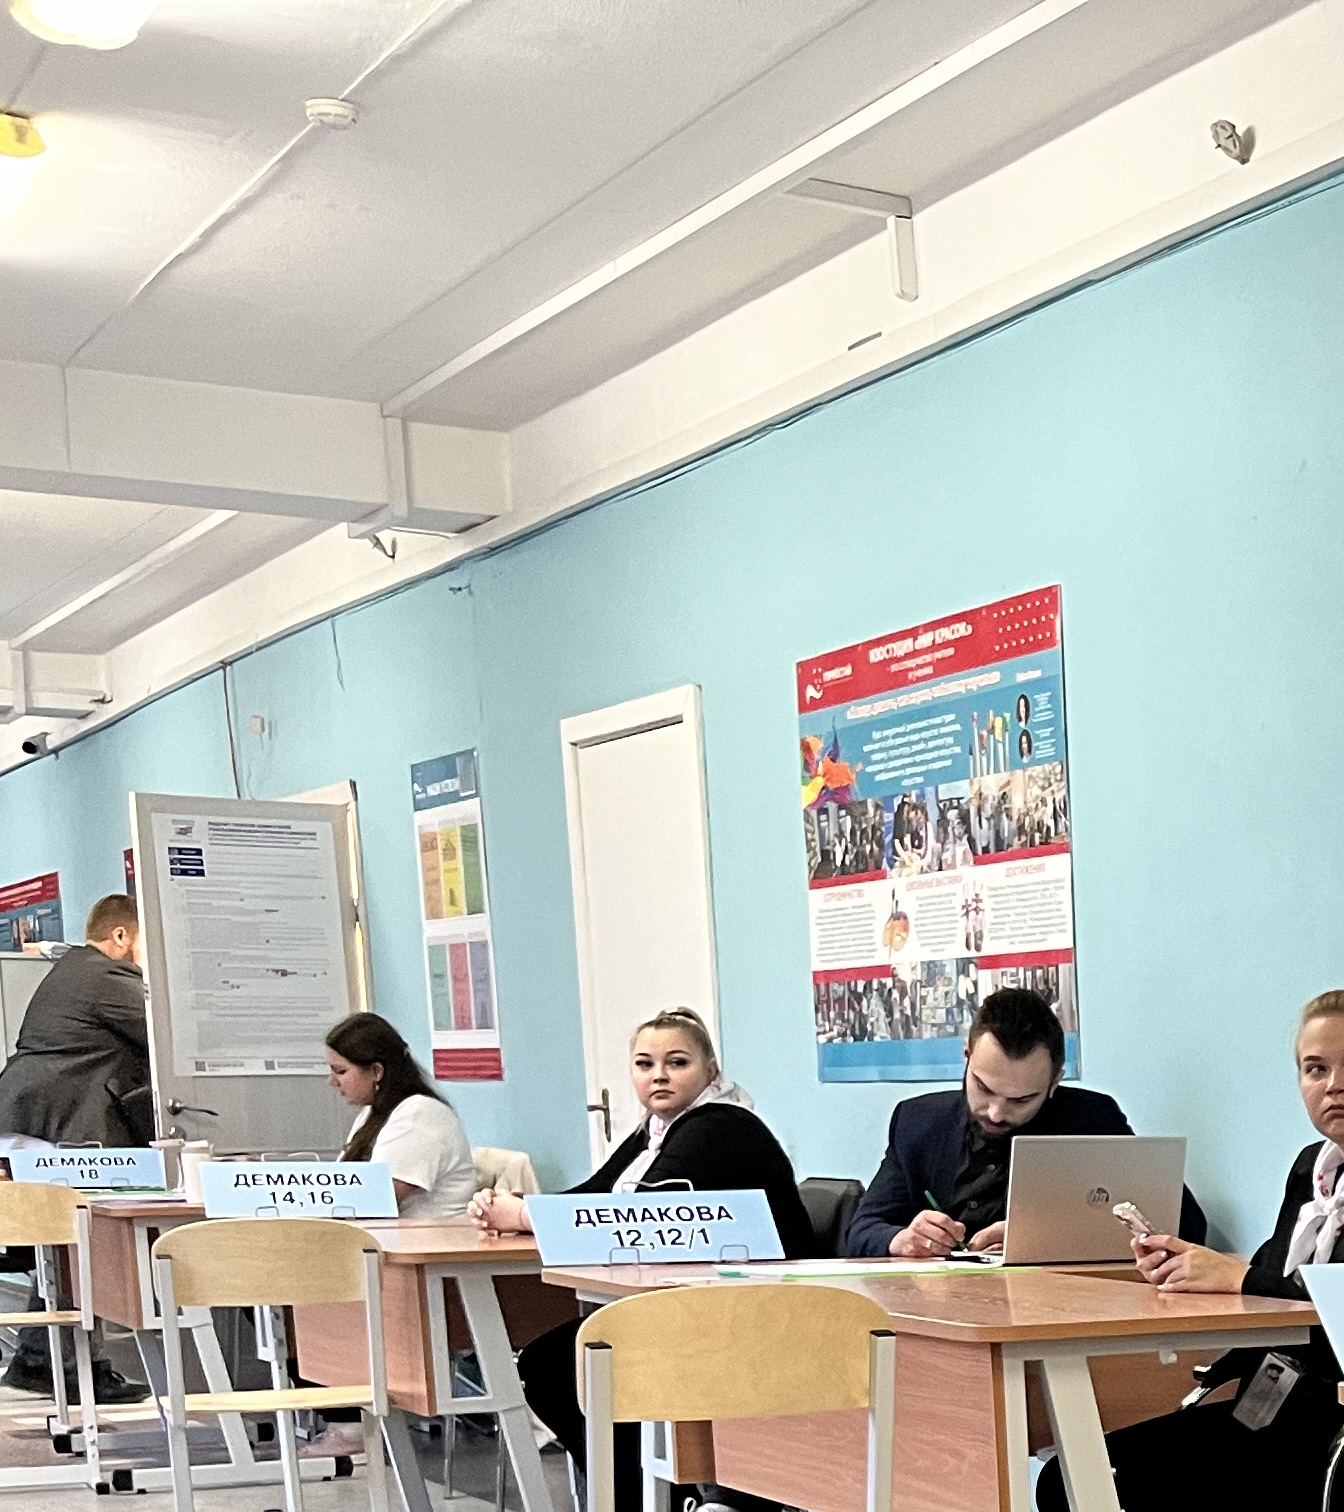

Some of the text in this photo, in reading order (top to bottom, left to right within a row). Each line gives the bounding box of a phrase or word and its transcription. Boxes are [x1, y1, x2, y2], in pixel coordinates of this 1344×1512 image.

[35, 1157, 137, 1169] ДЕМАКОВА
[233, 1173, 363, 1188] ДЕМАКОВА
[268, 1190, 335, 1208] 14,16
[573, 1203, 735, 1228] ДЕМАКОВА
[611, 1228, 711, 1251] 12,12/1
